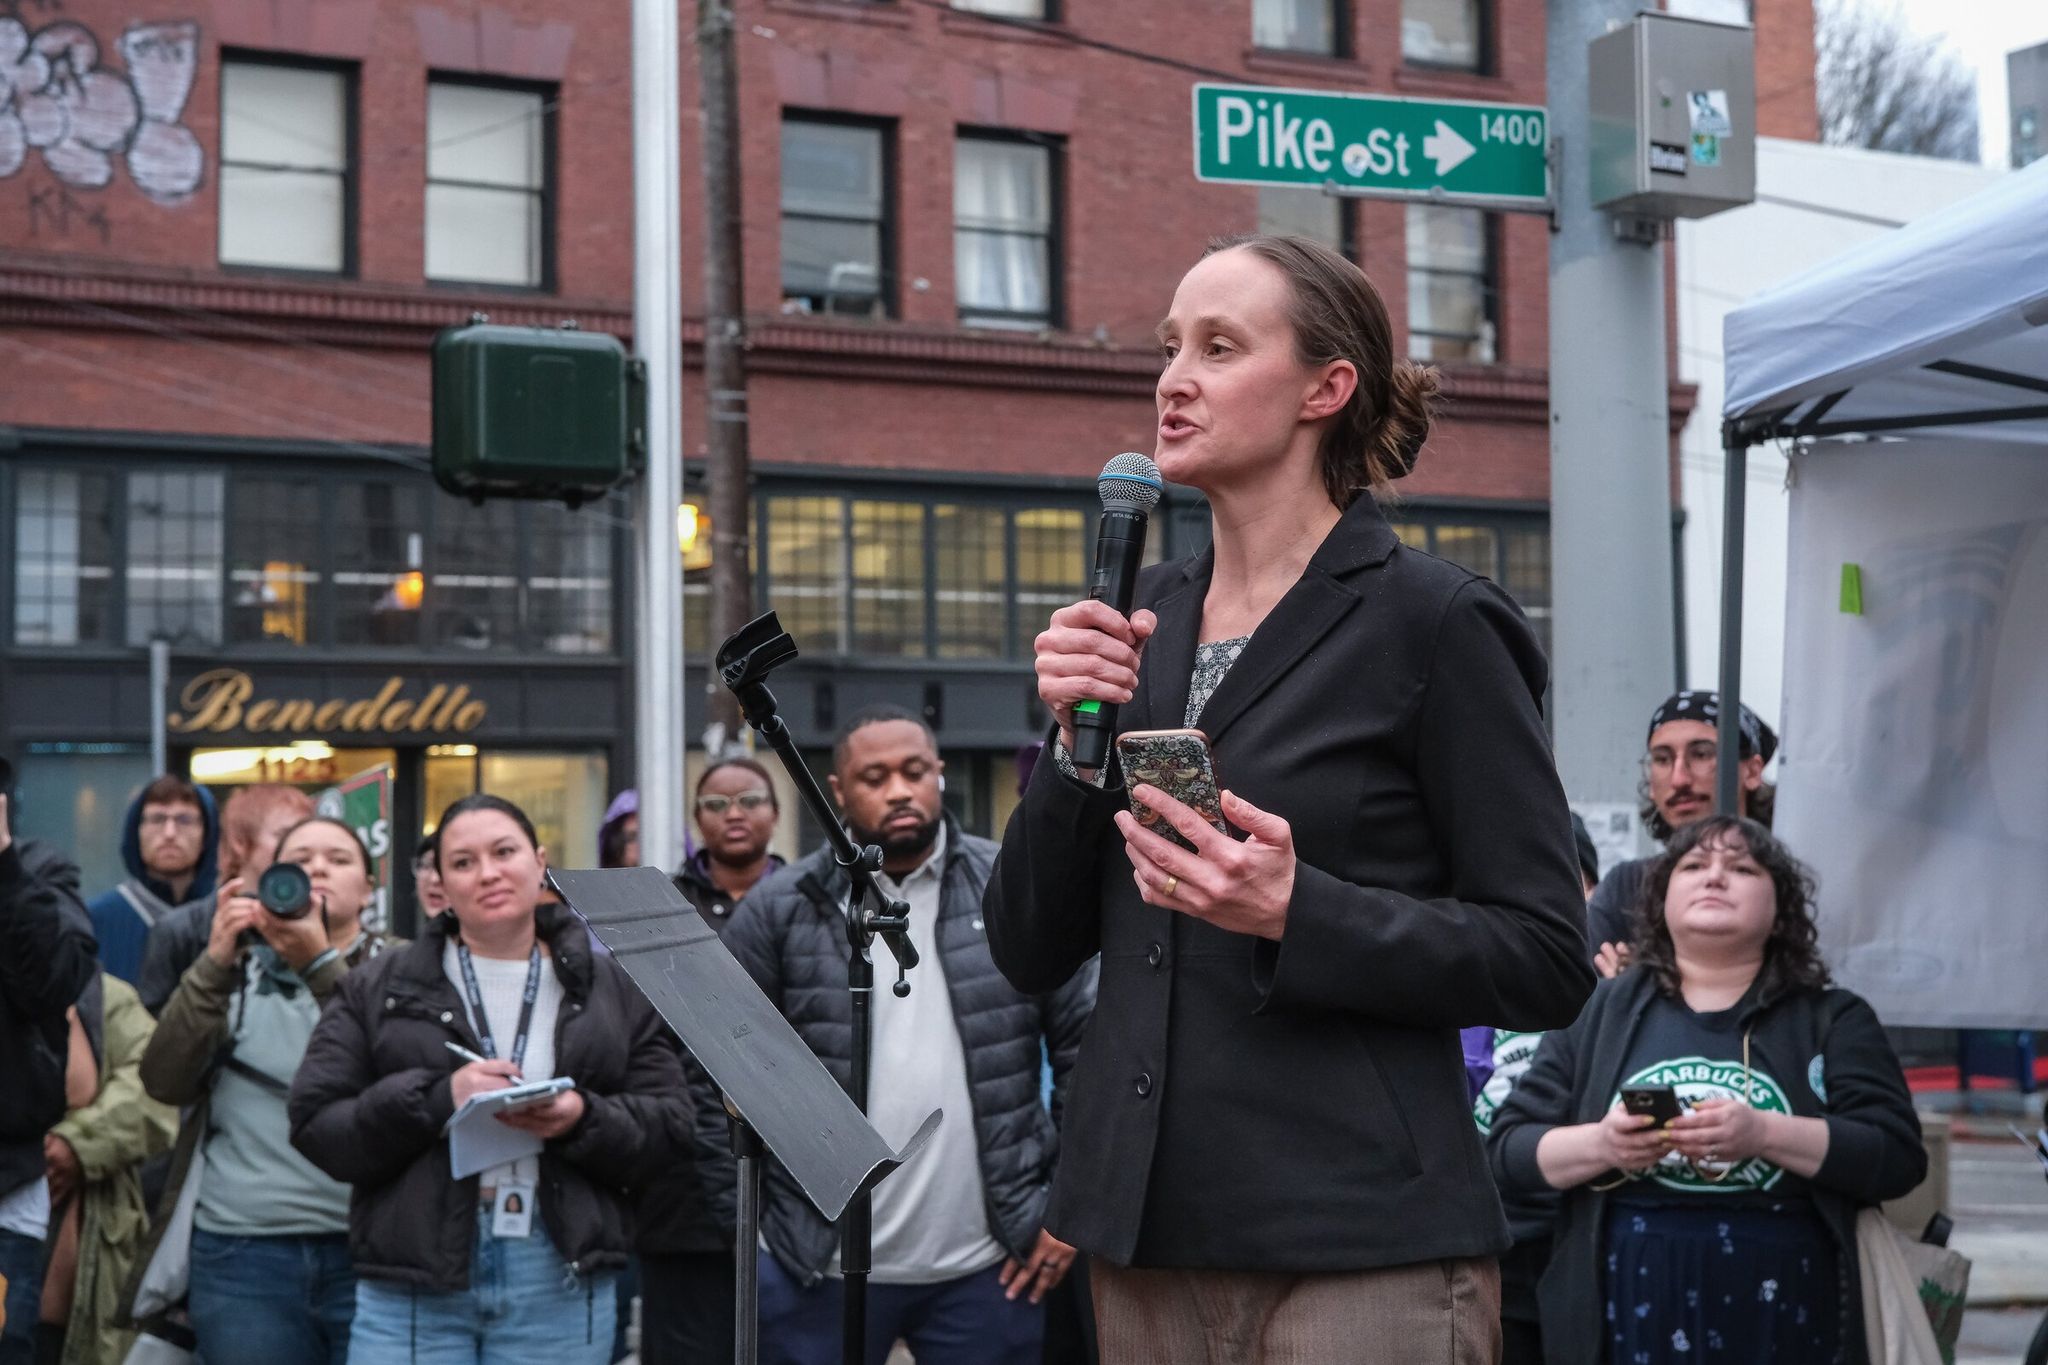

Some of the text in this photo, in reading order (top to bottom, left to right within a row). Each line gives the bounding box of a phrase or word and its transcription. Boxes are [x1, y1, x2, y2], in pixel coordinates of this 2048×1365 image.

[1216, 96, 1543, 177] Pike St 1400
[167, 667, 487, 733] Benedetto
[1642, 1063, 1773, 1105] TARBUCKS
